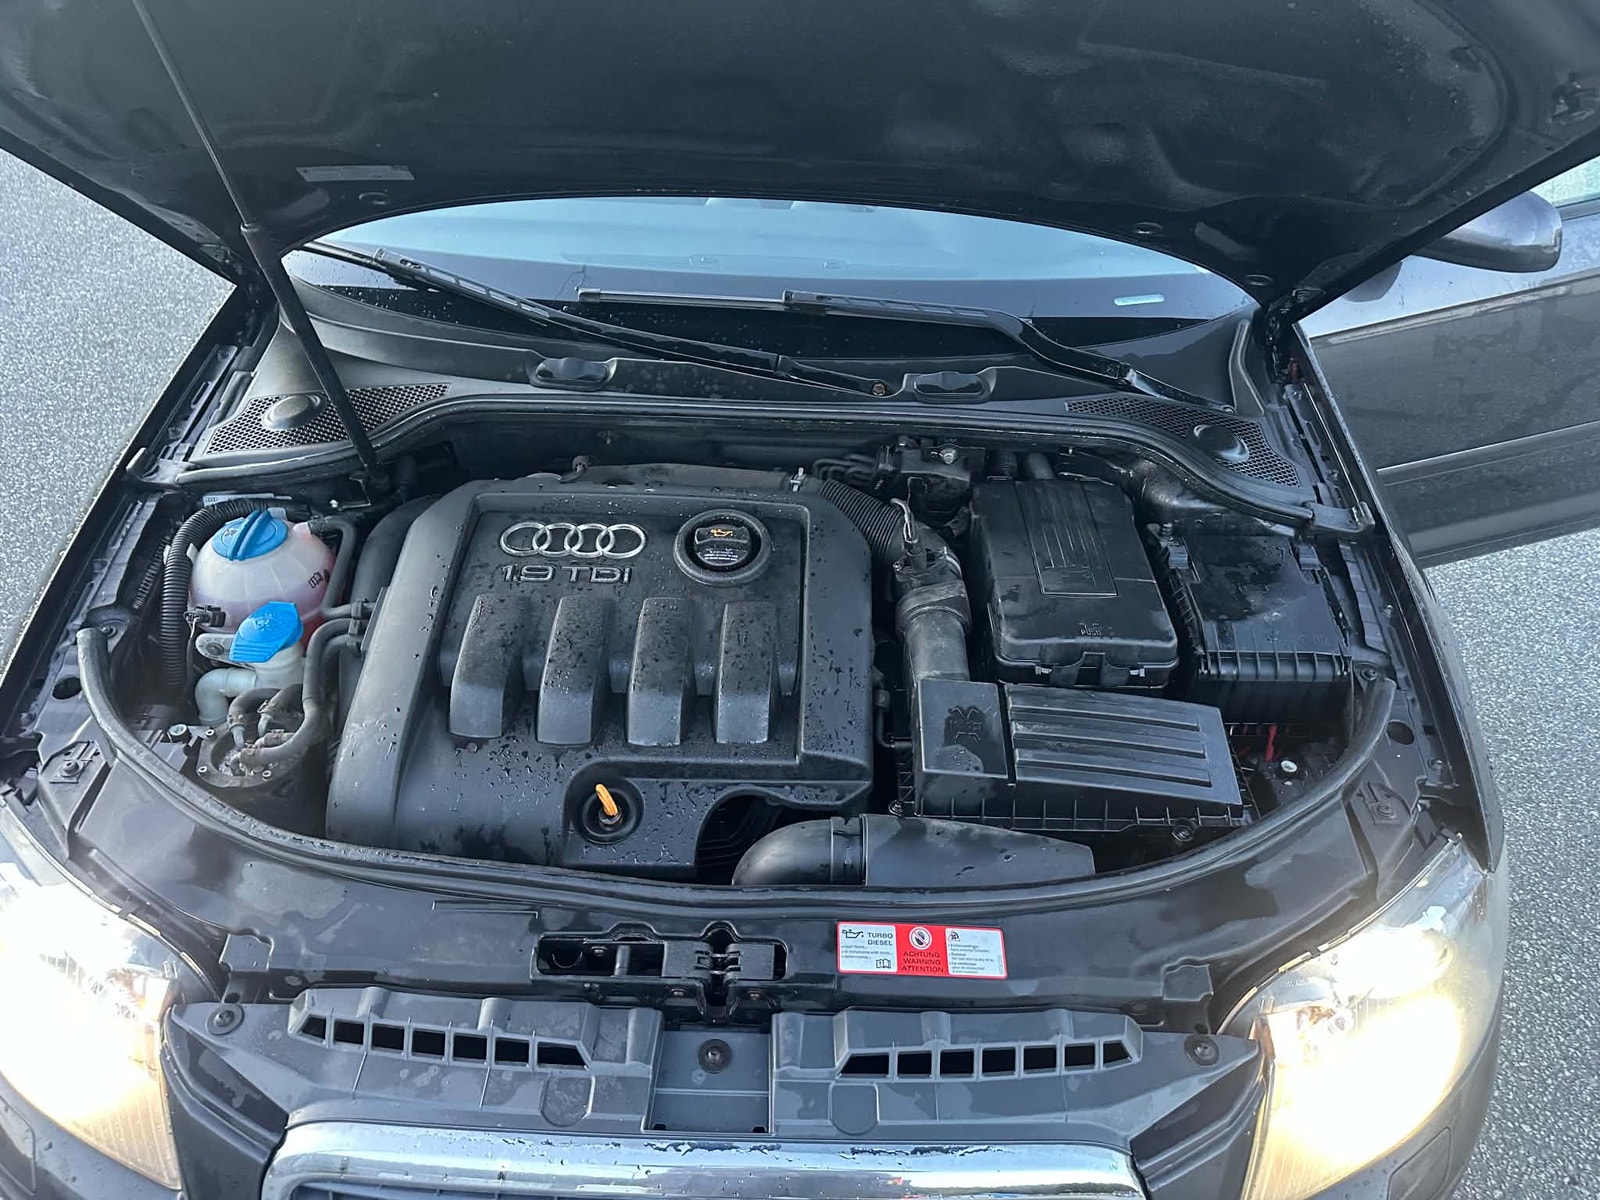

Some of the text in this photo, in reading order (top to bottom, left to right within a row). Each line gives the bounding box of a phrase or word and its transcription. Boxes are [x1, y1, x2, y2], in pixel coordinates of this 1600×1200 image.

[502, 564, 632, 584] 1.9 TDI
[903, 958, 941, 966] WARNING
[901, 965, 944, 973] ATTENTION
